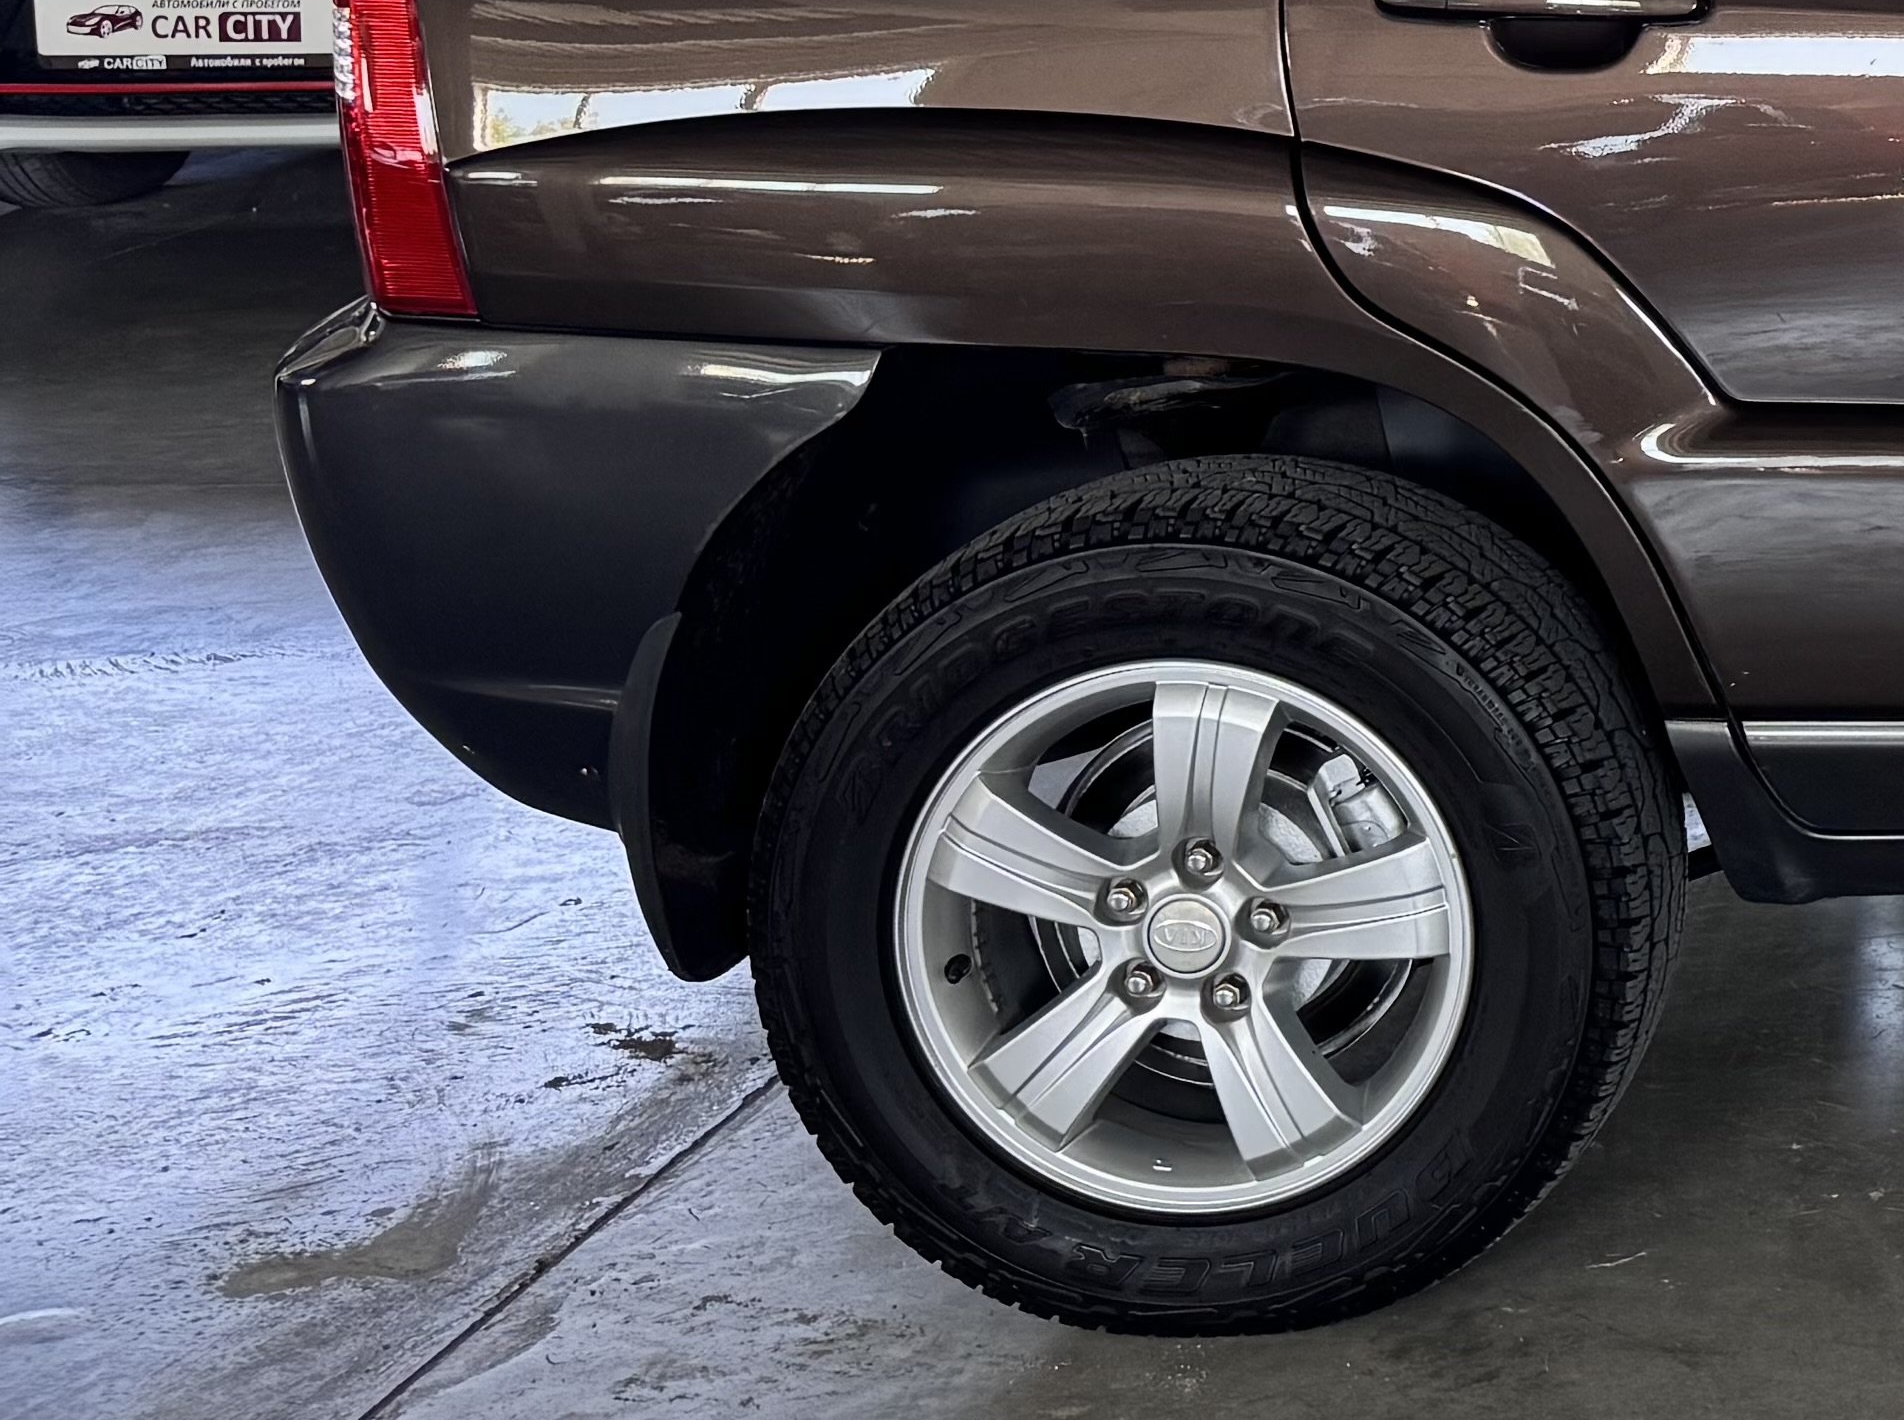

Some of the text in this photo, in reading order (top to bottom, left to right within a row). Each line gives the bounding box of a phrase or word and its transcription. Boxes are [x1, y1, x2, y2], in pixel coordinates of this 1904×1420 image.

[152, 0, 301, 9] АВТОМОБИЛИ С ПРОБЕГОМ
[151, 14, 294, 40] CAR CITY
[103, 57, 133, 69] CAR
[835, 588, 1380, 821] BRIDGESTONE
[1163, 925, 1208, 947] KIA
[1064, 1140, 1473, 1298] DUELER
